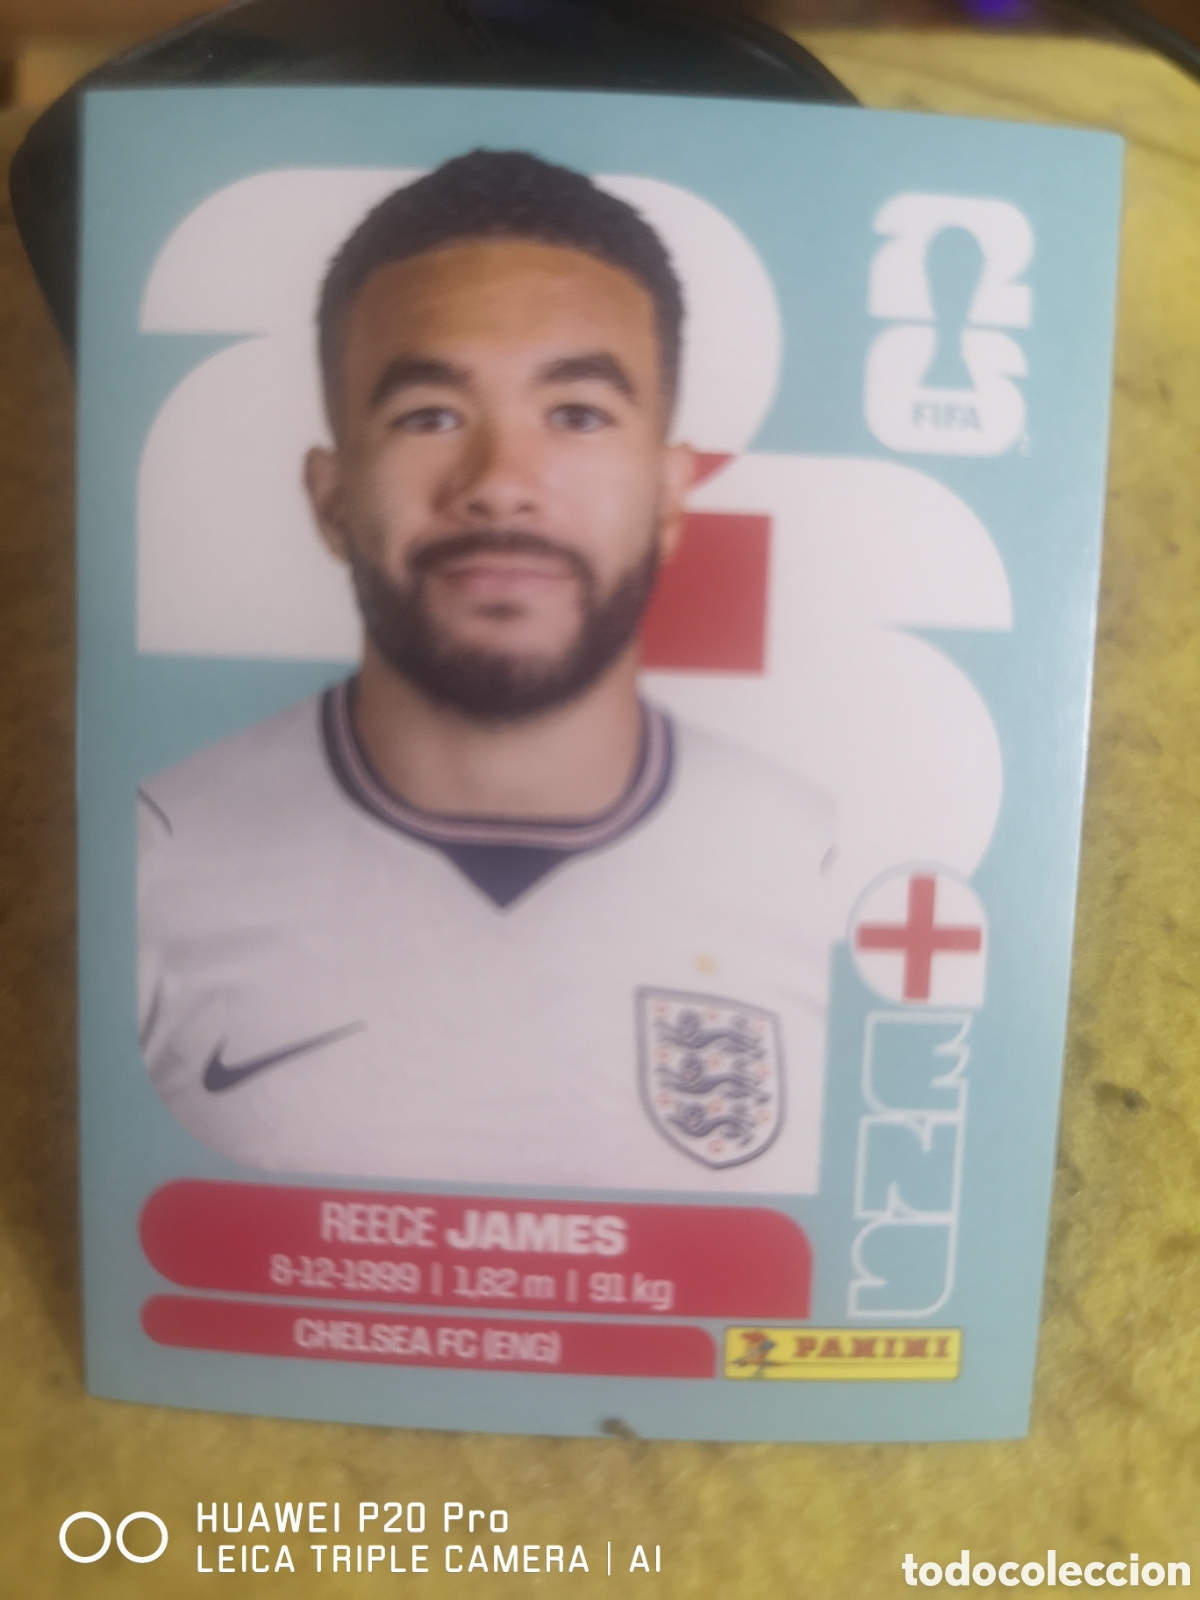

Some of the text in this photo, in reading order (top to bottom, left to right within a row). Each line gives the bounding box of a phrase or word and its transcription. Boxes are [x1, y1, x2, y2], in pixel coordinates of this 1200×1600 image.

[911, 401, 982, 431] FIFA
[321, 1201, 629, 1256] REECE JAMES
[269, 1253, 421, 1294] 8-12-1999
[452, 1265, 518, 1301] 1,82
[522, 1274, 556, 1300] m
[589, 1272, 624, 1302] 91
[632, 1273, 674, 1311] kg
[293, 1317, 562, 1365] CHELSEA FC (ENG)
[792, 1335, 952, 1359] PANINI
